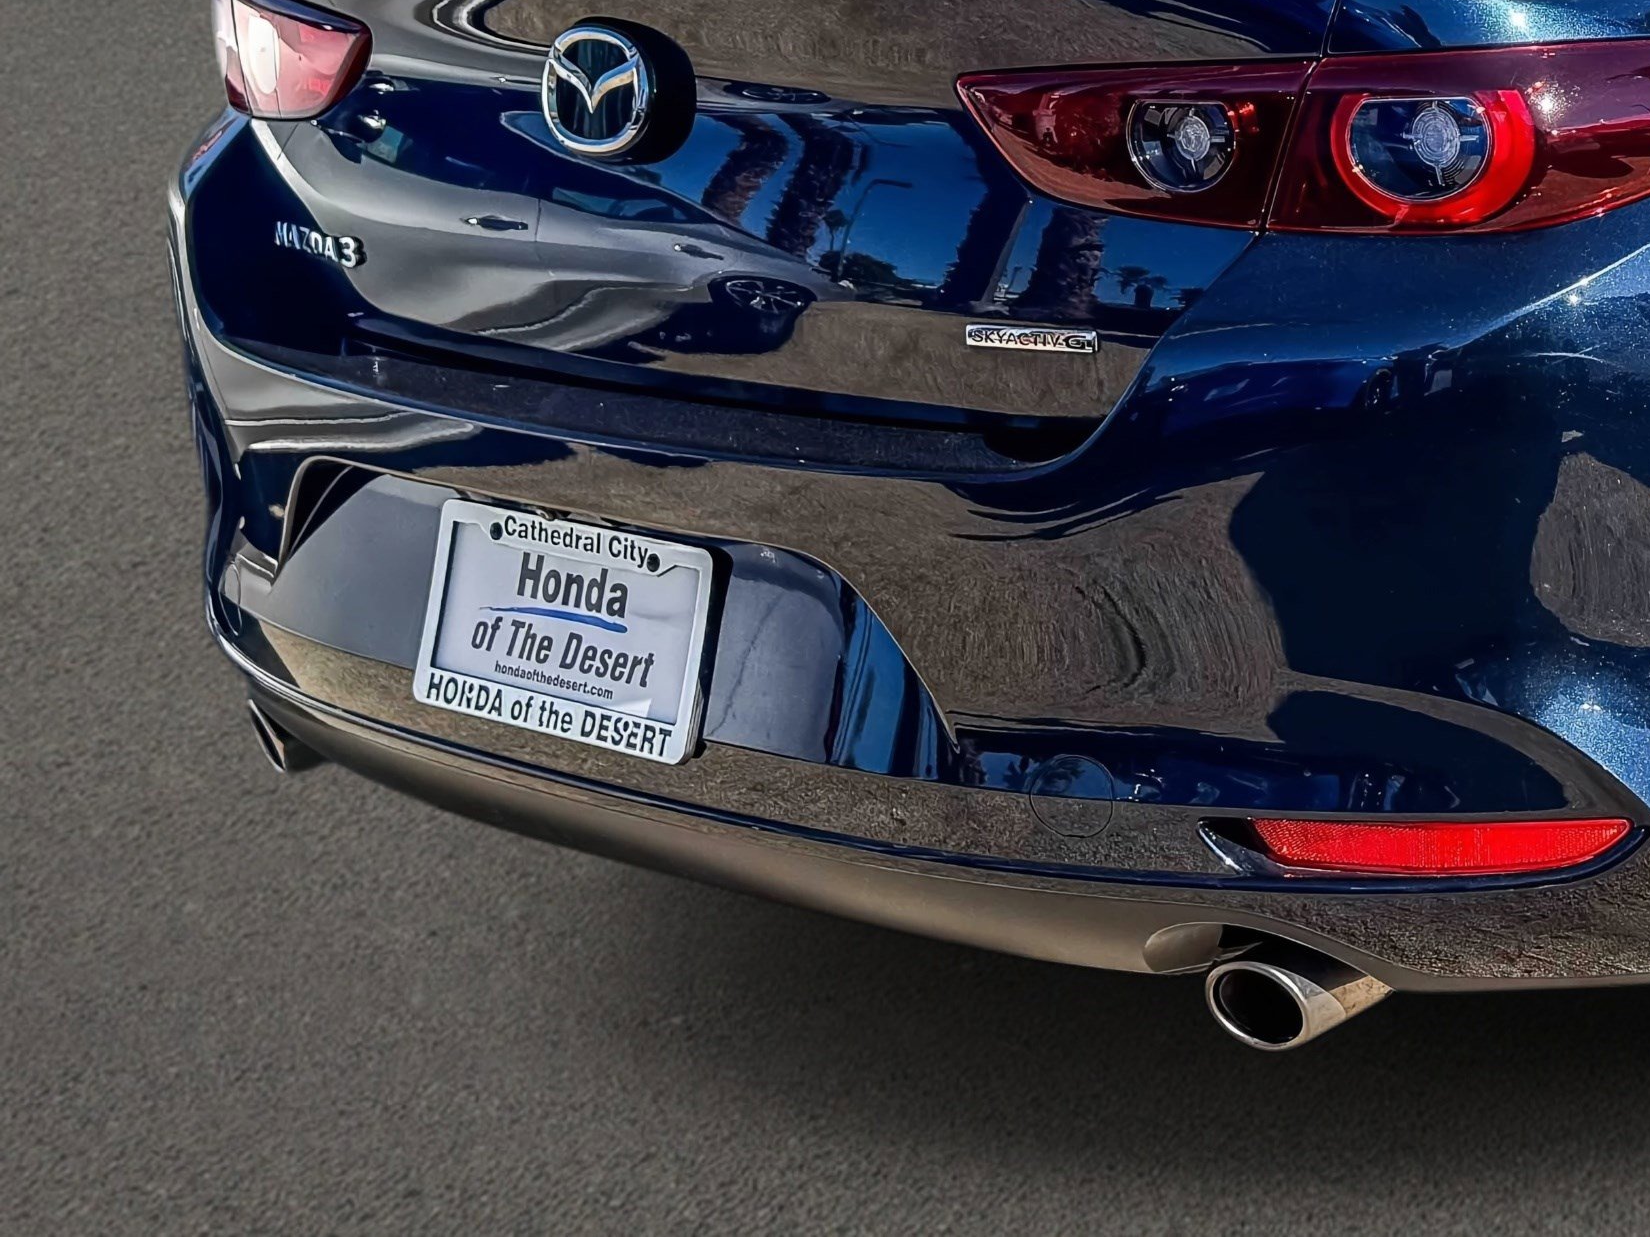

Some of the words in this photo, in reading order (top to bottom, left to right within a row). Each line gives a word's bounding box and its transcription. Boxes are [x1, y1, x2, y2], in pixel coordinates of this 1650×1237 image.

[503, 514, 601, 555] Cathedral
[608, 535, 649, 569] City
[516, 551, 629, 619] Honda
[470, 616, 504, 652] of
[505, 619, 554, 665] The
[558, 631, 655, 688] Desert
[494, 660, 614, 701] hondaofthedesert.com
[426, 672, 503, 717] HONDA
[510, 694, 534, 723] of
[538, 700, 574, 733] the
[580, 710, 673, 757] DESERT
